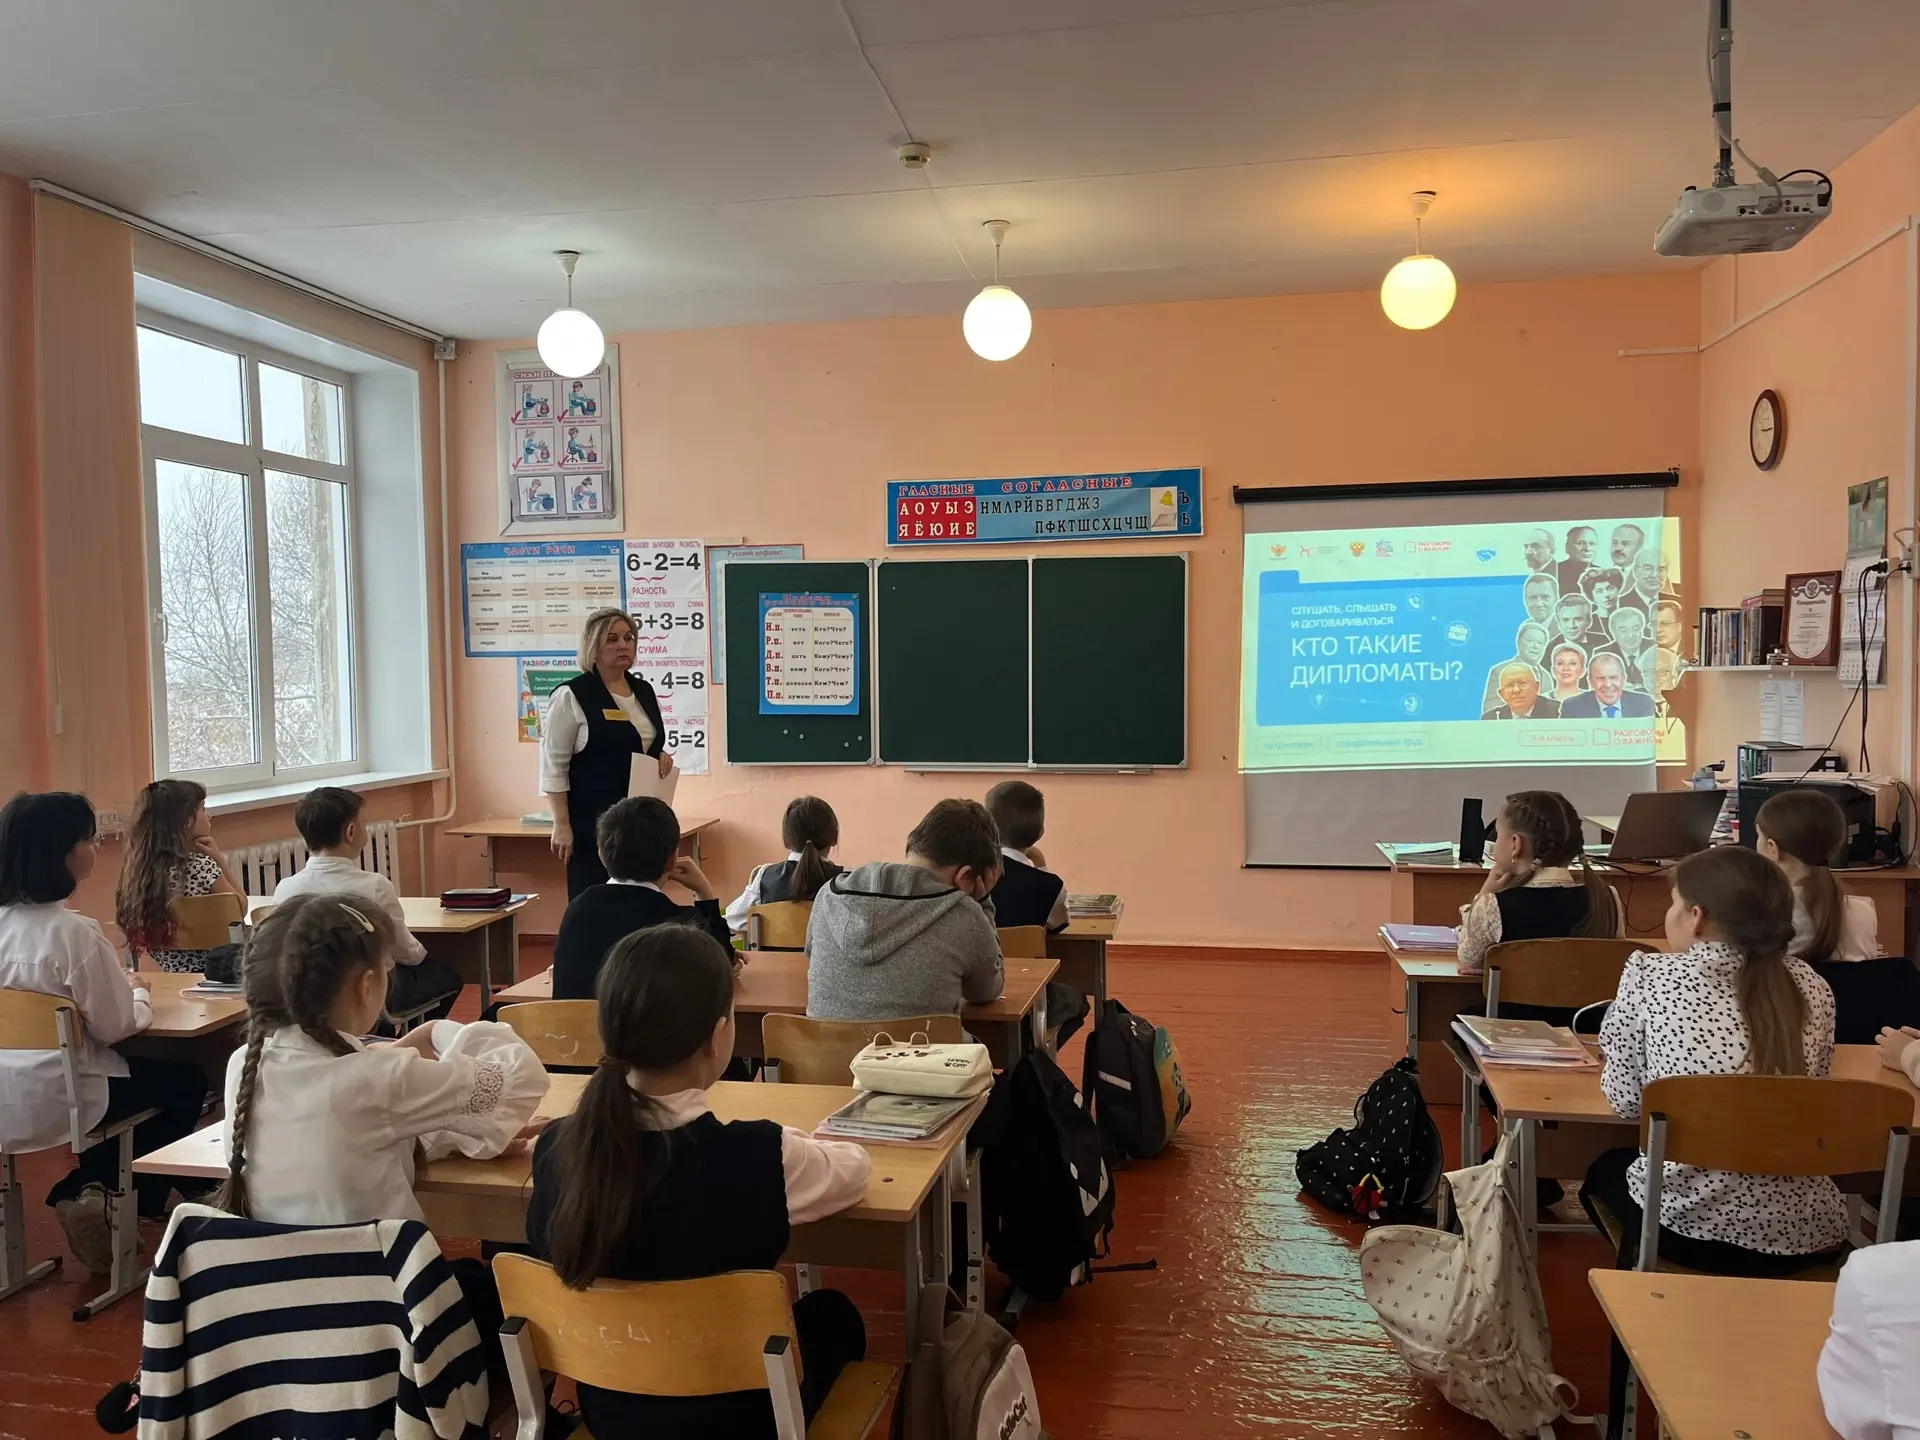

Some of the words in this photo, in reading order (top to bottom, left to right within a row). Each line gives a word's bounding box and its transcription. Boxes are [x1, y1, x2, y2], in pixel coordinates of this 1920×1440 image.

[899, 484, 974, 496] ГЛАСНЫЕ
[1002, 477, 1132, 493] СОГЛАСНЫЕ
[1179, 492, 1190, 504] Ъ
[1182, 513, 1191, 526] Ь
[504, 546, 540, 556] ЧАСТИ
[545, 545, 575, 554] РЕЧИ
[728, 550, 753, 558] Русский
[626, 553, 700, 571] 6-2=4
[632, 587, 667, 595] РАЗНОСТЬ
[1292, 606, 1342, 616] СЛУШАТЬ,
[1345, 603, 1397, 613] СЛЫШАТЬ
[632, 612, 704, 630] 5+3=8
[1291, 620, 1299, 628] И
[1301, 617, 1393, 629] ДОГОВАРИВАТЬСЯ
[766, 636, 782, 645] Р.п.
[1292, 636, 1338, 657] КТО
[1345, 634, 1422, 655] ТАКИЕ
[638, 646, 668, 654] СУММА
[766, 650, 783, 660] Д.п.
[766, 664, 783, 672] В.п.
[1290, 661, 1463, 688] ДИПЛОМАТЫ?
[766, 677, 782, 685] Т.п.
[668, 731, 705, 748] 5=2
